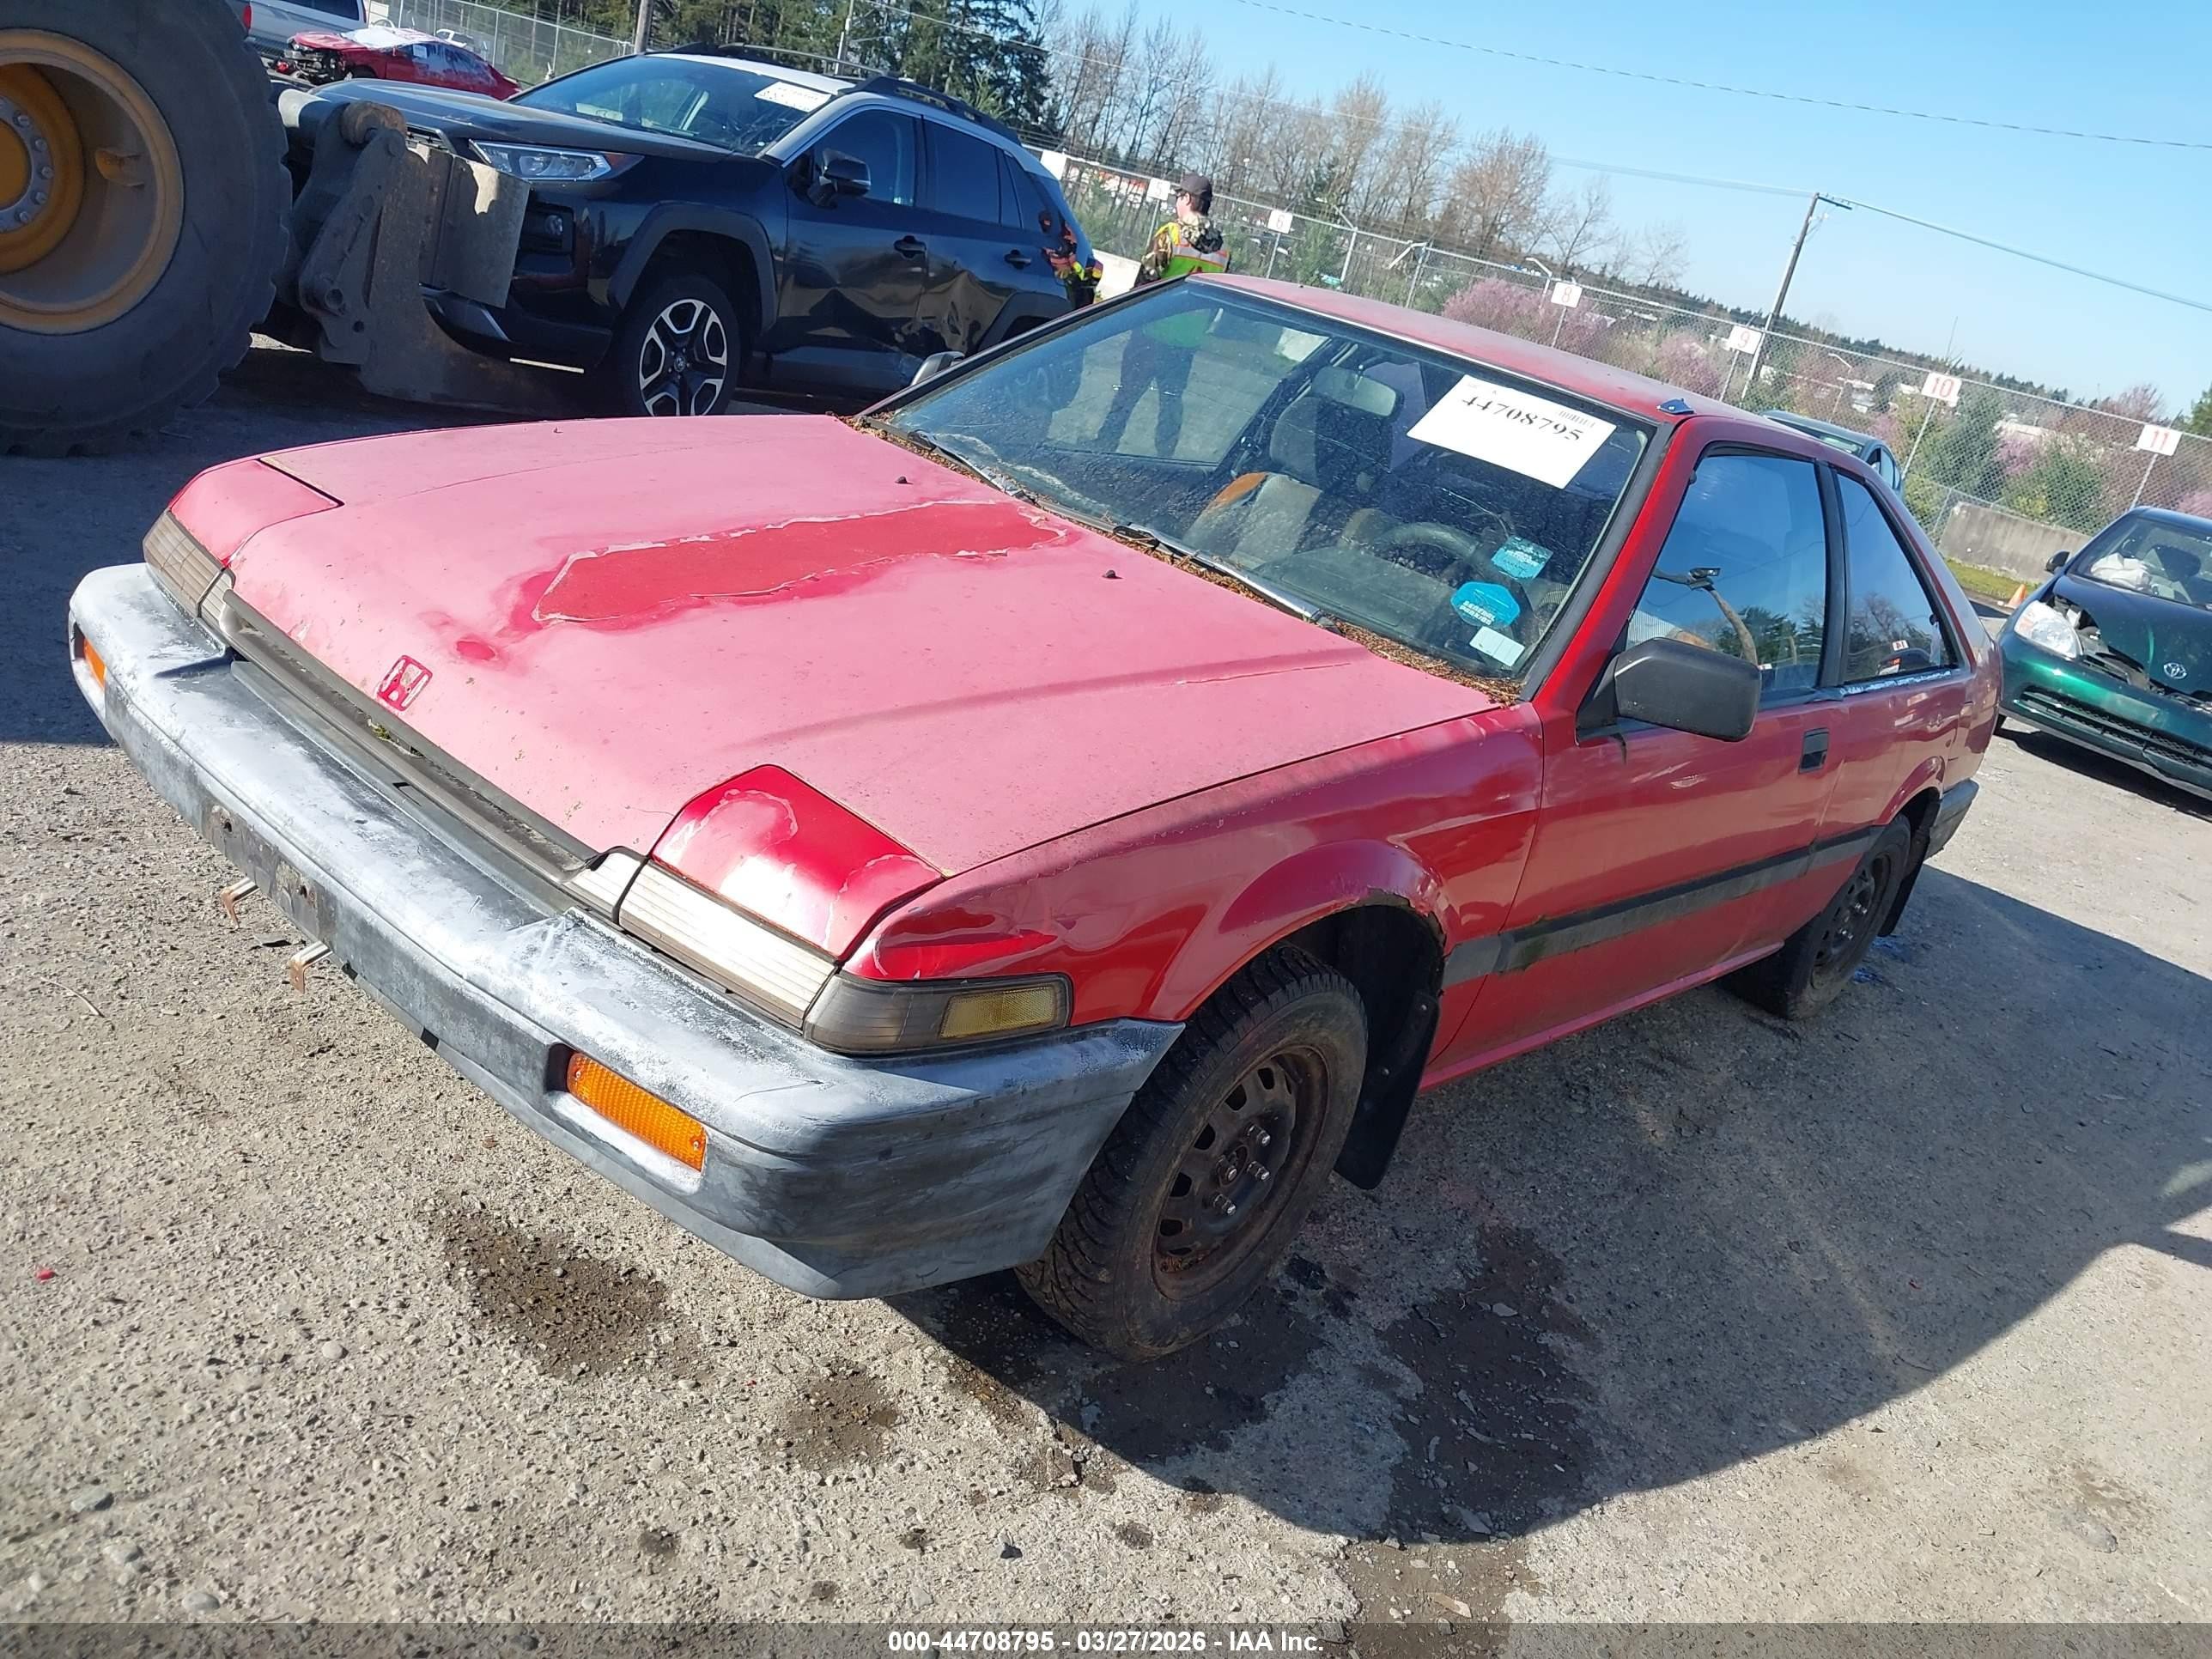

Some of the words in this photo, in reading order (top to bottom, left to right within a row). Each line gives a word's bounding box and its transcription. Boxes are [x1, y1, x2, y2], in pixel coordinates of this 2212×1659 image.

[1277, 215, 1285, 230] 6
[1562, 286, 1572, 303] 8
[1738, 331, 1750, 349] 9
[1931, 377, 1954, 398] 10
[1462, 396, 1584, 441] 44708795
[2149, 430, 2170, 451] 11
